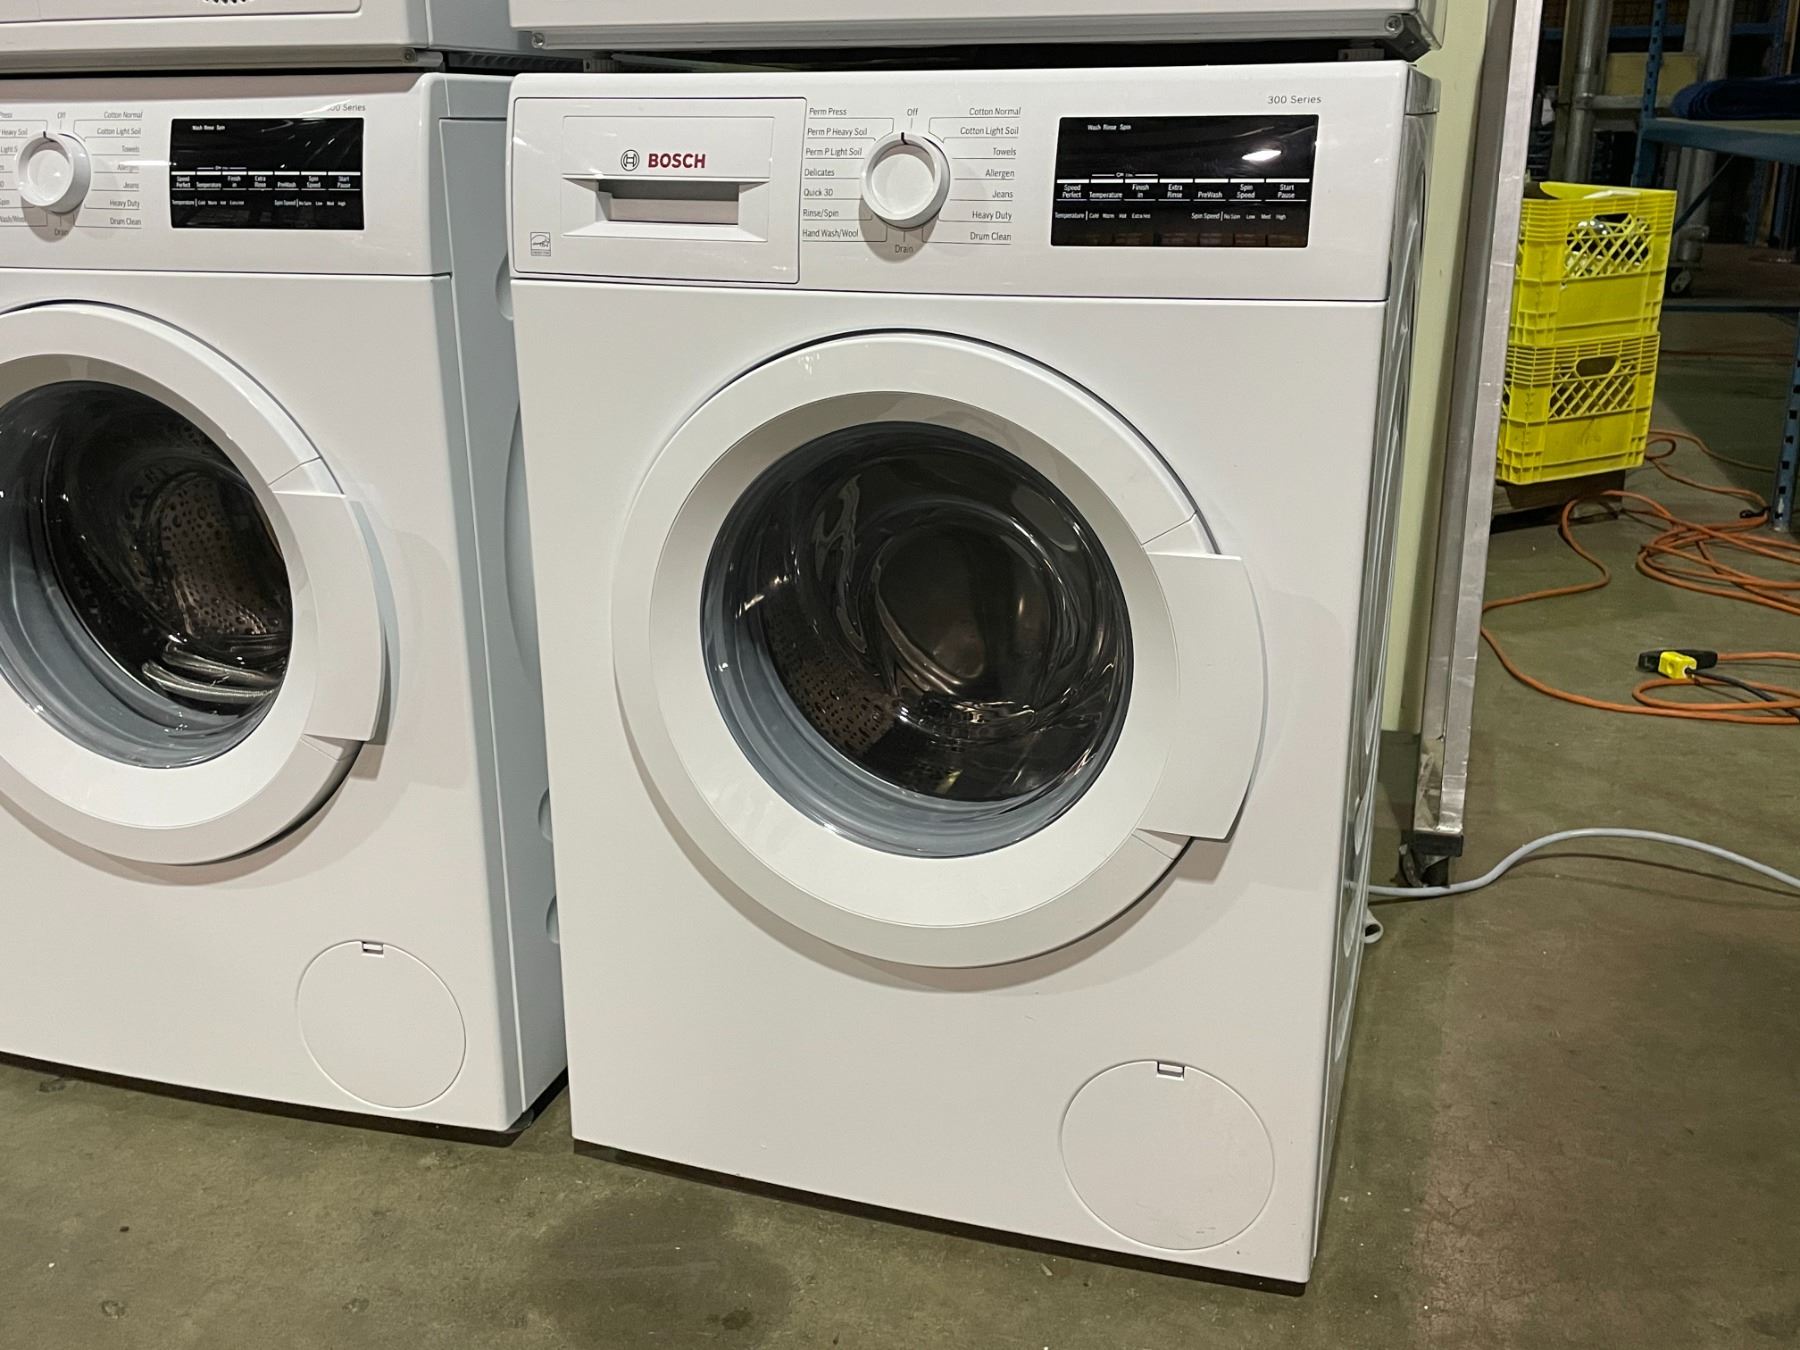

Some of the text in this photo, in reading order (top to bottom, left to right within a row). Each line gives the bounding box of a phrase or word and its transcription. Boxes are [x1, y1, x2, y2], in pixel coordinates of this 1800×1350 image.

[1268, 95, 1322, 104] 300 Series
[907, 108, 918, 116] Off
[995, 107, 1021, 115] Normal
[116, 128, 130, 136] Light
[832, 128, 853, 136] Heavy
[986, 127, 1003, 136] Light
[1005, 126, 1019, 135] Soil
[830, 148, 848, 156] Light
[648, 154, 706, 168] BOSCH
[985, 169, 1015, 180] Allergen
[127, 200, 140, 208] Duty
[802, 209, 839, 217] Rinse/Spin
[972, 210, 1012, 221] Heavy Duty
[802, 228, 859, 239] Hand Wash/Wool
[970, 232, 1012, 240] Drum Clean
[895, 244, 914, 253] Drain
